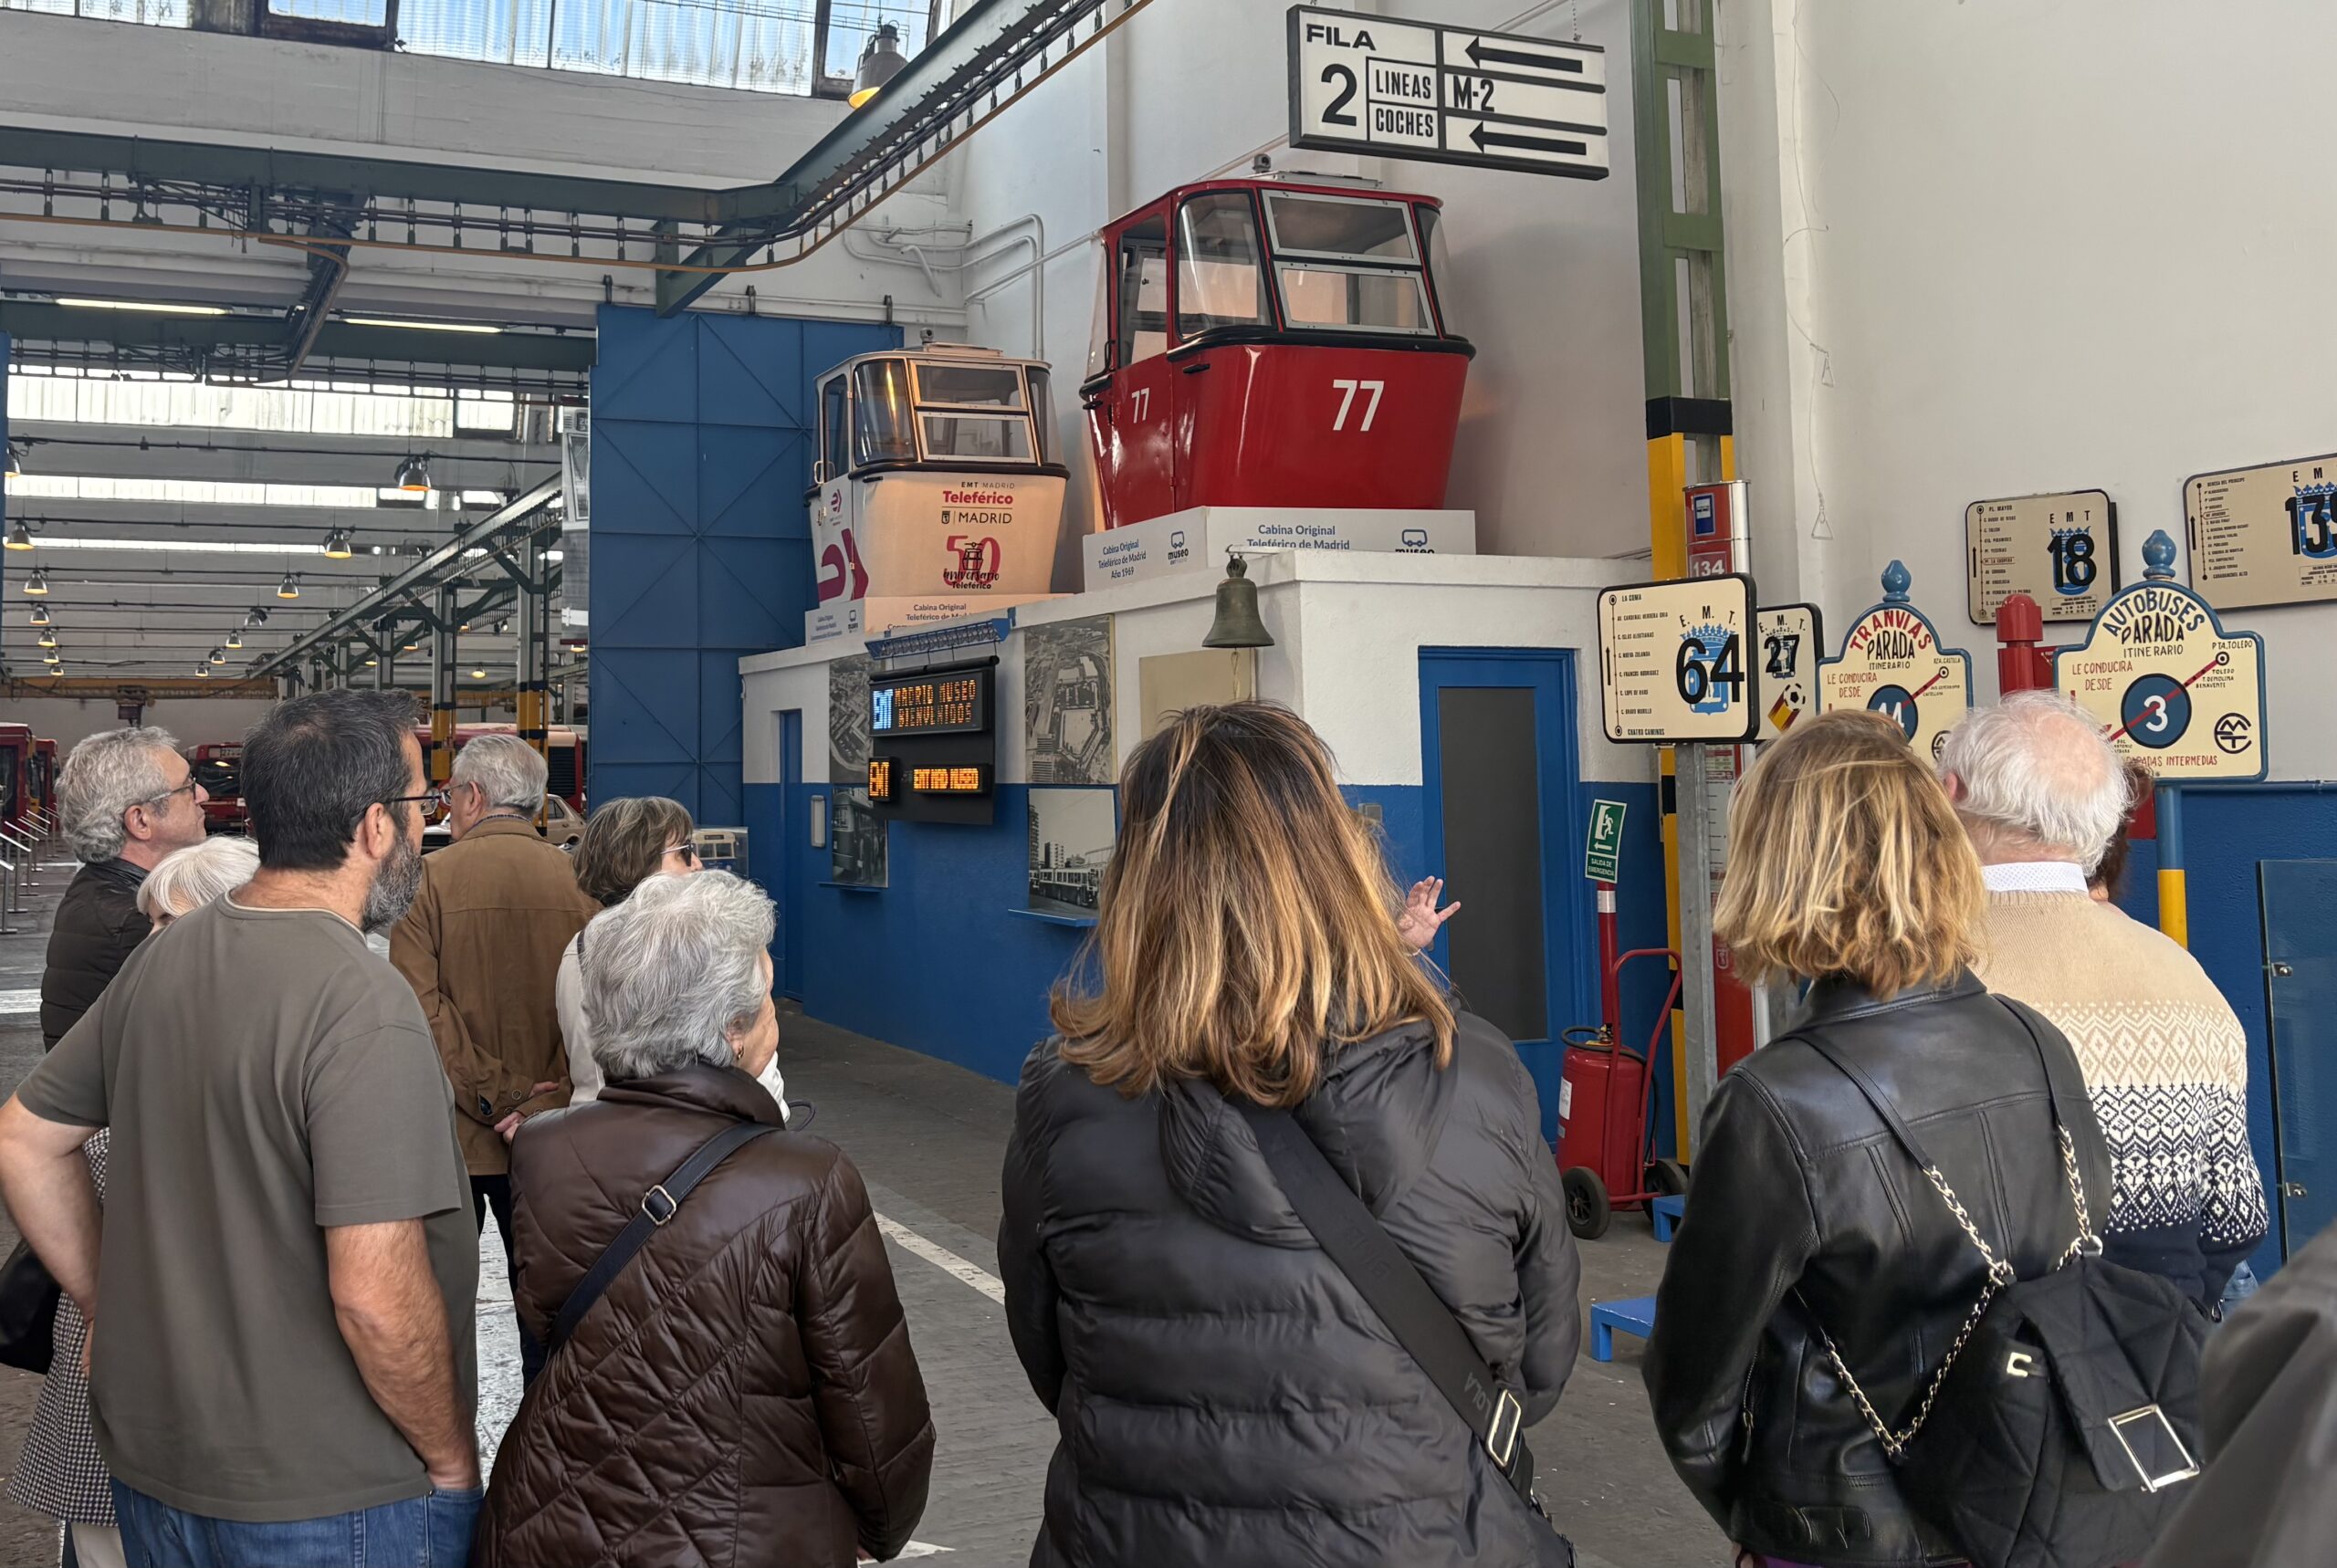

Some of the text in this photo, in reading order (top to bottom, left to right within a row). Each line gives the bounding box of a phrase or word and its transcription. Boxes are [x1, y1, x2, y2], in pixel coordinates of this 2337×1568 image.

[1306, 24, 1377, 51] FILA
[1376, 68, 1431, 99] LINEAS
[1321, 63, 1357, 127] 2
[1453, 74, 1495, 112] M-2
[1376, 108, 1434, 138] COCHES
[1131, 387, 1149, 423] 77
[1332, 379, 1385, 432] 77
[2313, 466, 2323, 480] M
[942, 490, 1013, 505] Teleférico
[958, 512, 1012, 524] MADRID
[2049, 510, 2091, 524] E M T
[2285, 492, 2337, 556] 13
[1258, 525, 1336, 537] Cabina Original
[1103, 541, 1119, 556] Cabina
[1299, 538, 1312, 549] de
[1314, 538, 1350, 549] Madrid
[1122, 555, 1129, 564] de
[1129, 550, 1147, 562] Madrid
[1168, 549, 1189, 560] museo
[2047, 534, 2098, 588] 18
[1693, 559, 1725, 578] 134
[951, 581, 992, 590] Teleférico
[938, 603, 967, 613] Original
[1702, 604, 1715, 620] M.
[1728, 610, 1736, 626] T.
[2102, 590, 2206, 637] AUTOBUSES
[907, 613, 939, 622] Teleférico
[1776, 614, 1787, 626] M.
[1798, 618, 1807, 632] T.
[1850, 610, 1933, 651] TRANVIAS
[2121, 612, 2185, 644] PARADA
[1764, 633, 1800, 674] 27
[1867, 630, 1915, 661] PARADA
[1676, 633, 1745, 706] 64
[1869, 661, 1911, 670] ITINERARIO
[2071, 660, 2133, 675] LE CONDUCIRA
[1827, 672, 1878, 685] LE CONDUCIRA
[2084, 677, 2113, 691] DESDE
[895, 679, 976, 707] MADRID MUSEO
[1839, 686, 1861, 698] DESDE
[2143, 695, 2169, 732] 3
[2165, 755, 2218, 766] INTERMEDIAS
